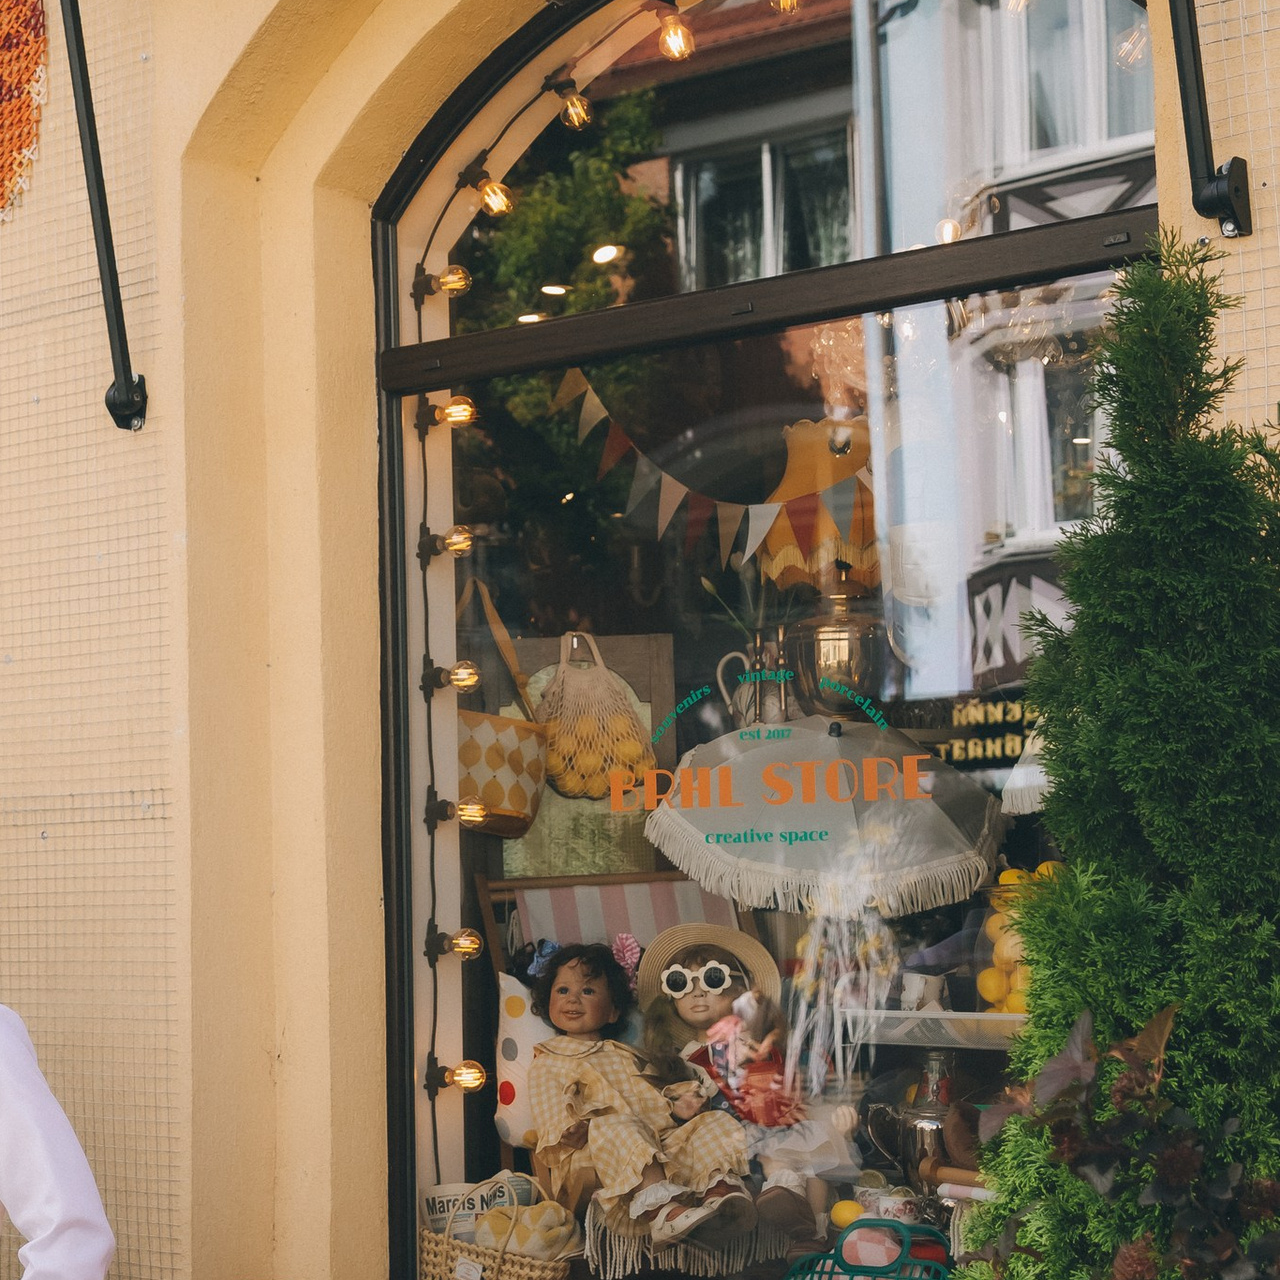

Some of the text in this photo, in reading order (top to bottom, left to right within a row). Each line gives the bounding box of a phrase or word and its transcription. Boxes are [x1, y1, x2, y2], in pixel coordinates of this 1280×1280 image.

[736, 669, 795, 686] vintage
[651, 682, 712, 744] souvenirs
[819, 675, 890, 732] porcelain
[739, 727, 793, 741] est 2017
[609, 753, 934, 813] BRHL STORE
[704, 828, 829, 846] creative space
